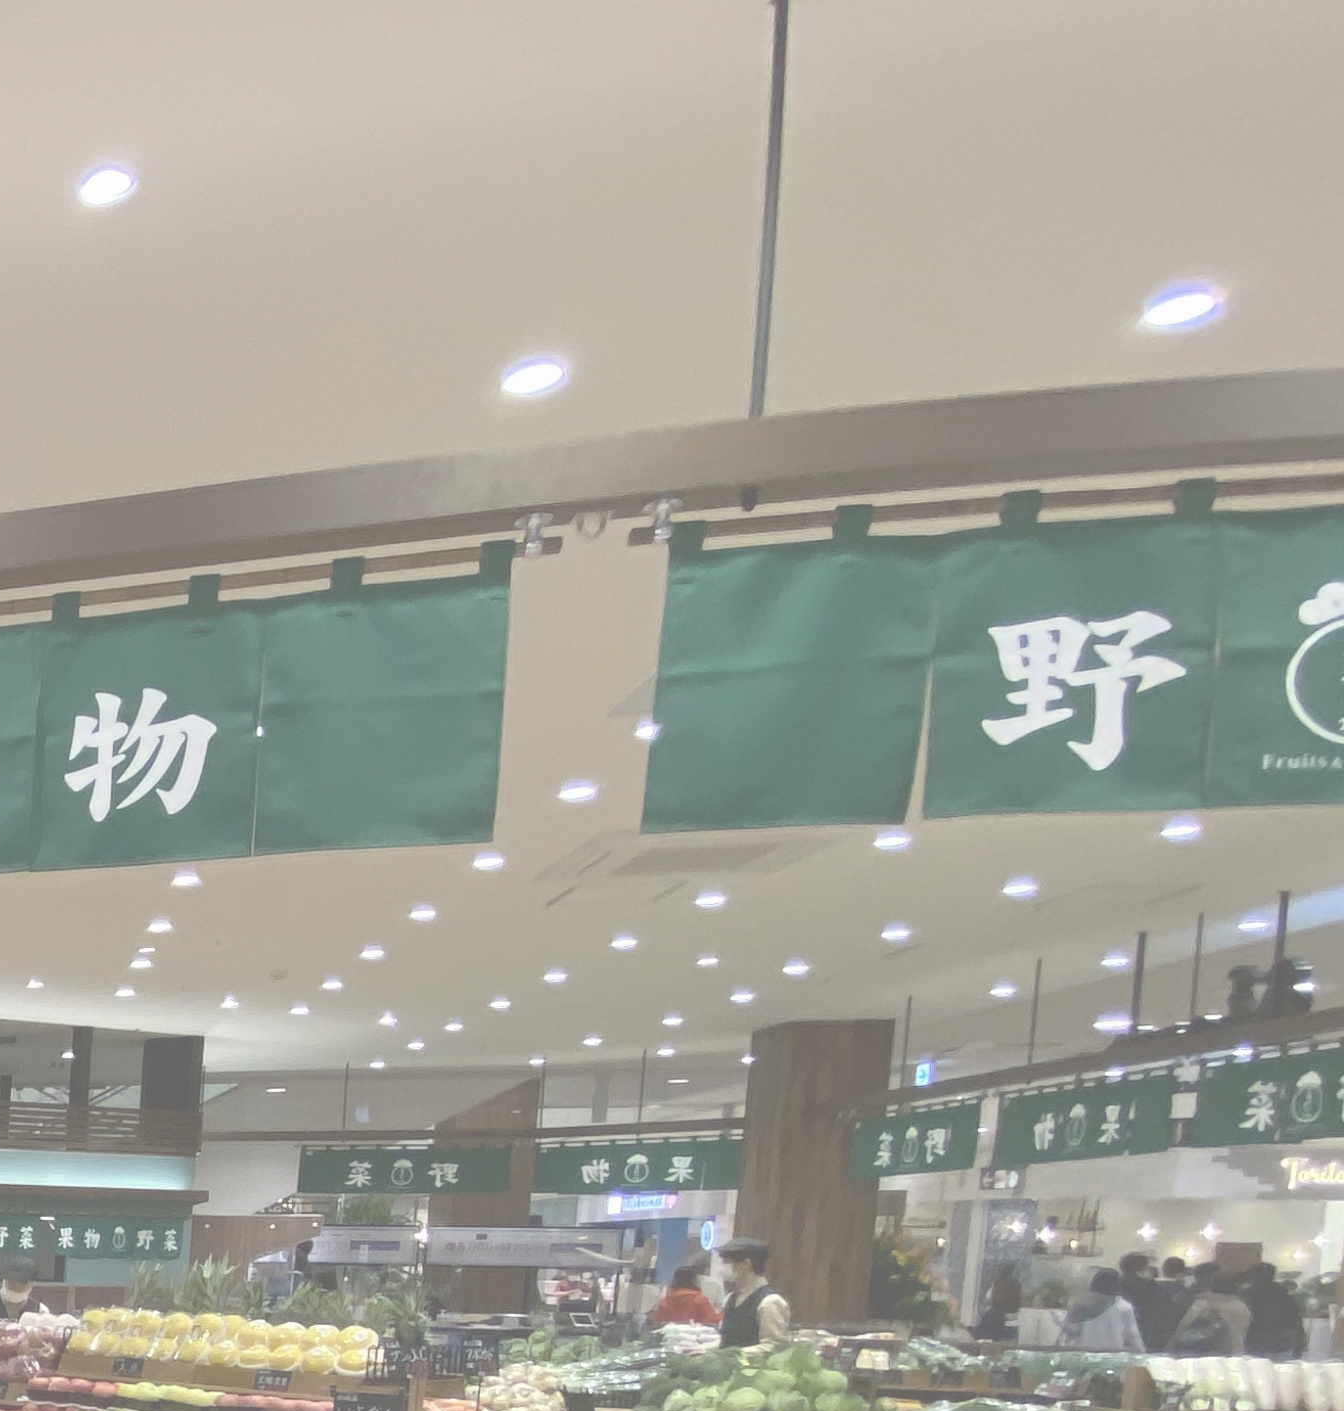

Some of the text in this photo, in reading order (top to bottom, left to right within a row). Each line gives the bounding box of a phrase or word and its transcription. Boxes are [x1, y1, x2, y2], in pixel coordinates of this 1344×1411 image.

[64, 688, 217, 822] 物
[982, 611, 1186, 770] 野
[1262, 753, 1328, 770] Fruits
